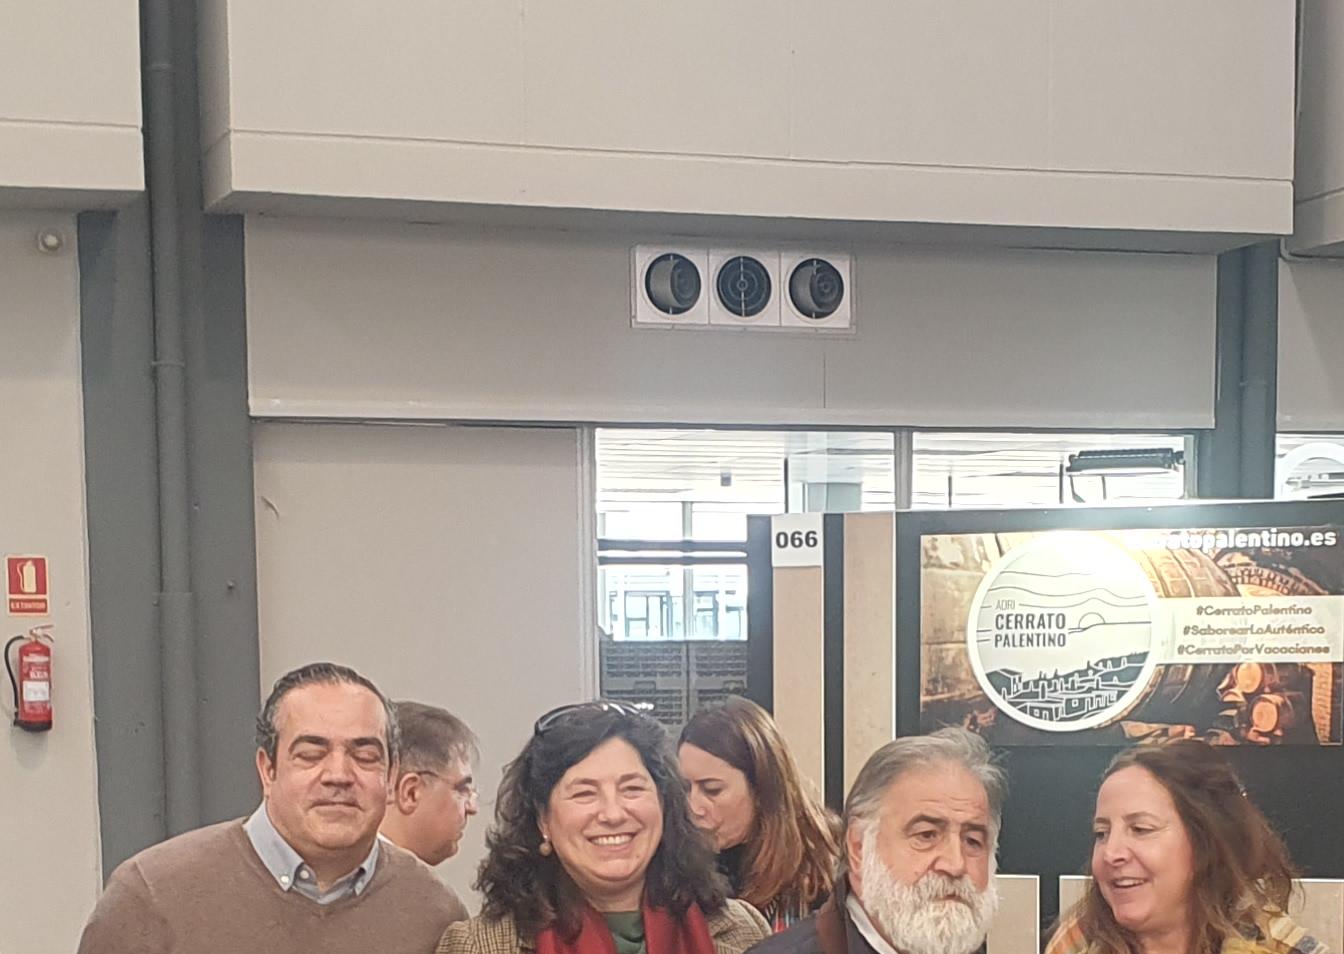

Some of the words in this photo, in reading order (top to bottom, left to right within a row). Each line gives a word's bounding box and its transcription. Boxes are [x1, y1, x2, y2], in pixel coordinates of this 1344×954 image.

[775, 530, 818, 549] 066
[1196, 604, 1313, 616] #CerratoPalentino
[995, 613, 1066, 630] CERRATO
[994, 633, 1066, 648] PALENTINO
